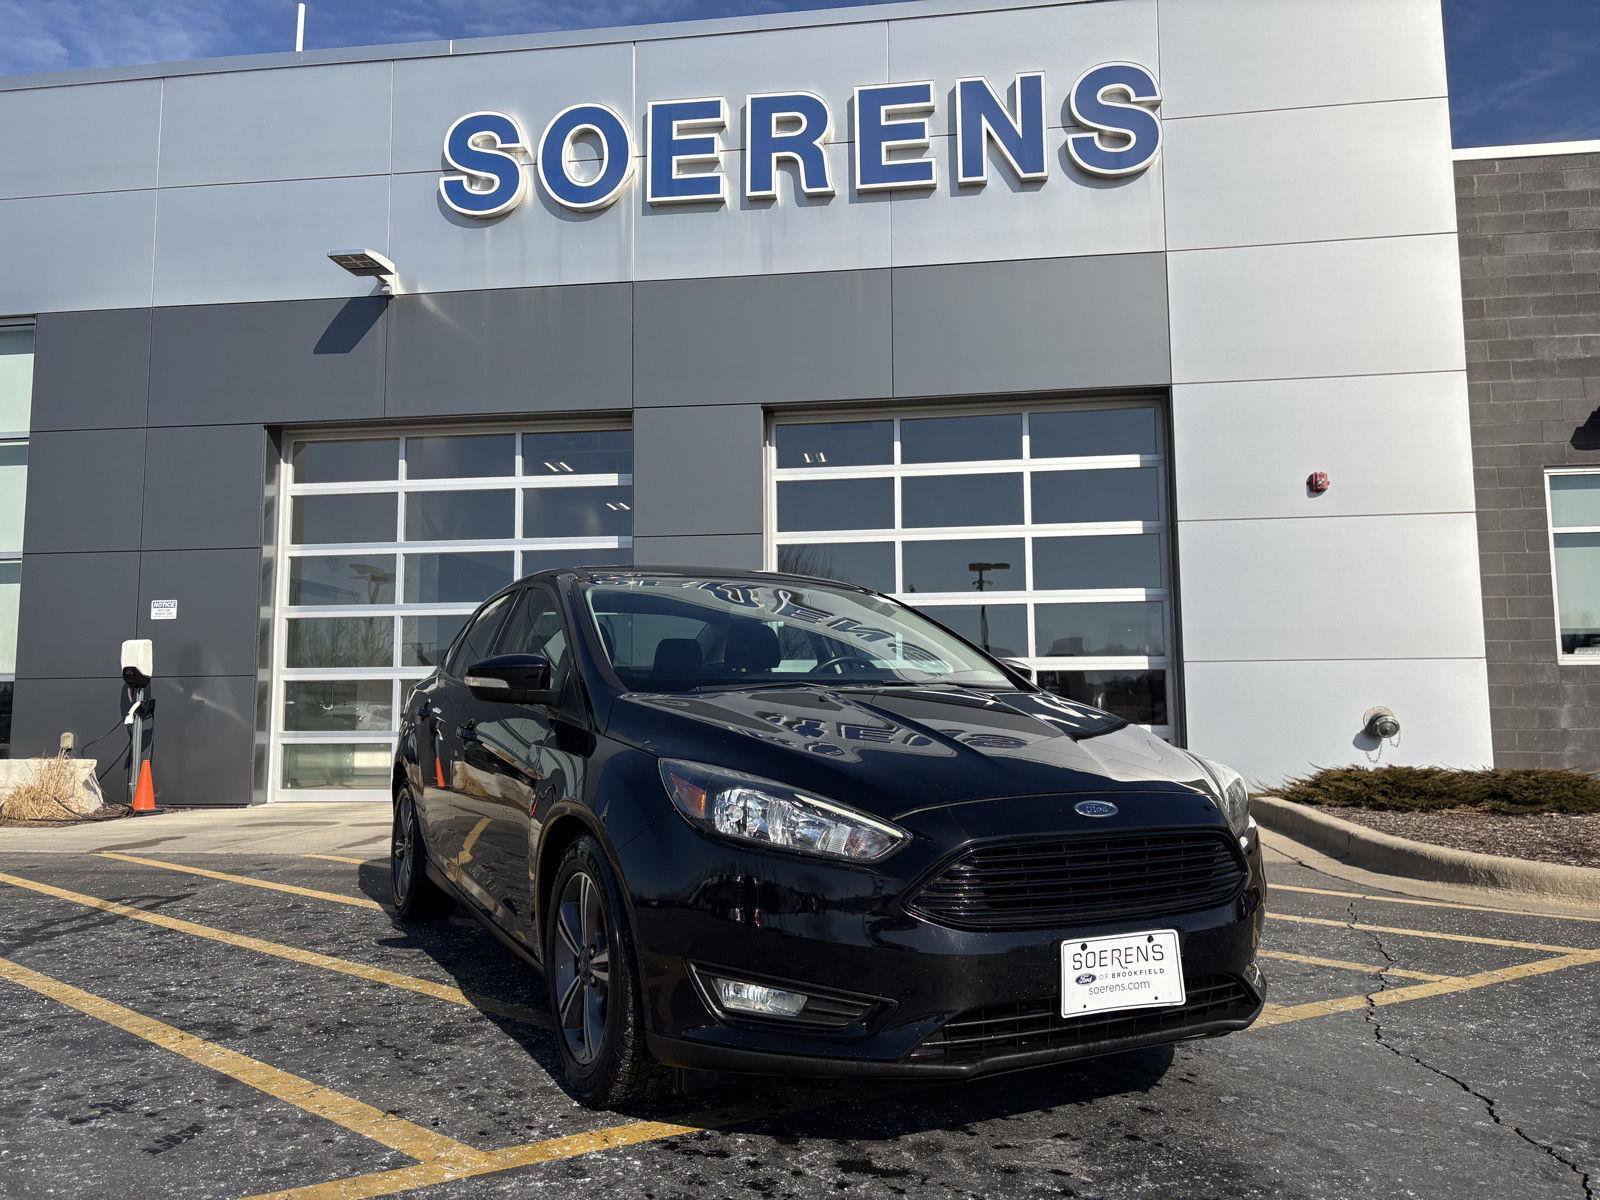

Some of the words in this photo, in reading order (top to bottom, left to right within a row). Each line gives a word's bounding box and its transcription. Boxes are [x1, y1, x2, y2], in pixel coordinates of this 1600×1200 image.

[438, 61, 1163, 219] SOERENS
[1072, 943, 1164, 970] SOERENS
[1098, 973, 1109, 981] OF
[1111, 968, 1165, 979] BROOKFIELD
[1088, 980, 1151, 996] soerens.com
